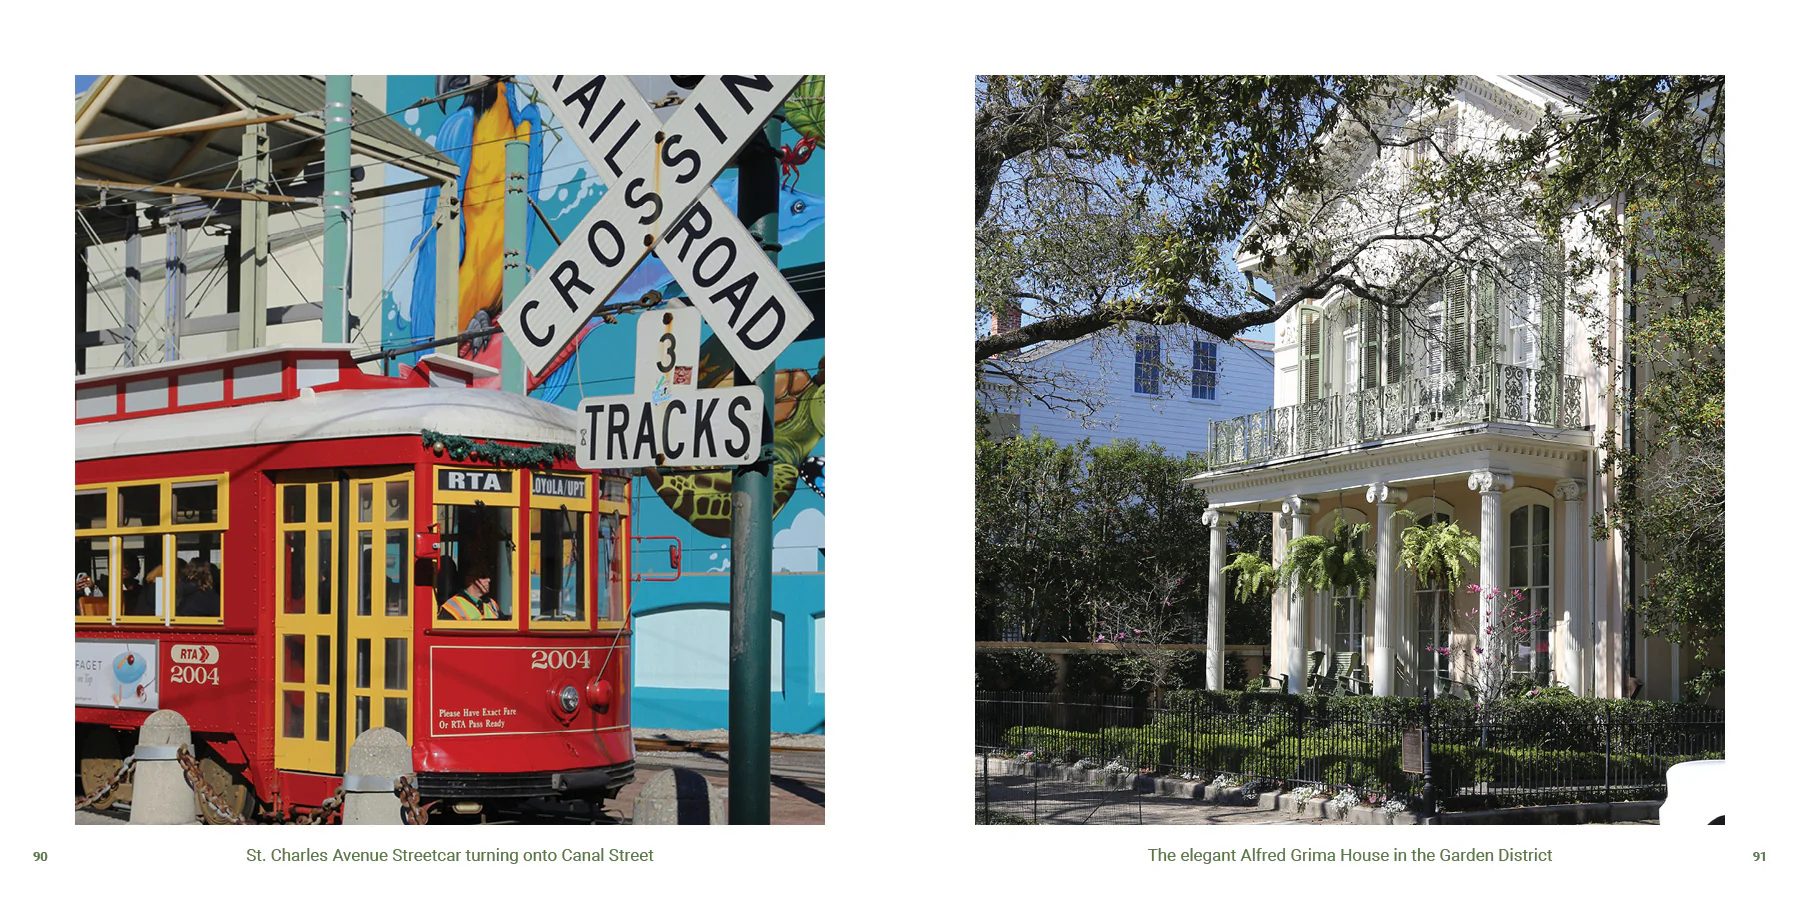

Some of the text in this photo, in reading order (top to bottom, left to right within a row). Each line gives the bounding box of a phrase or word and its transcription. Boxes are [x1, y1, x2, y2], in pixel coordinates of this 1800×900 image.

[664, 201, 786, 351] ROAD
[656, 333, 676, 373] 3
[585, 396, 752, 460] TRACKS
[448, 471, 501, 490] RTA
[180, 649, 197, 660] RTA
[531, 650, 590, 669] 2004
[170, 665, 219, 685] 2004
[439, 707, 517, 717] Please Have Exact Fare
[439, 719, 505, 729] Or RTA Pass Ready
